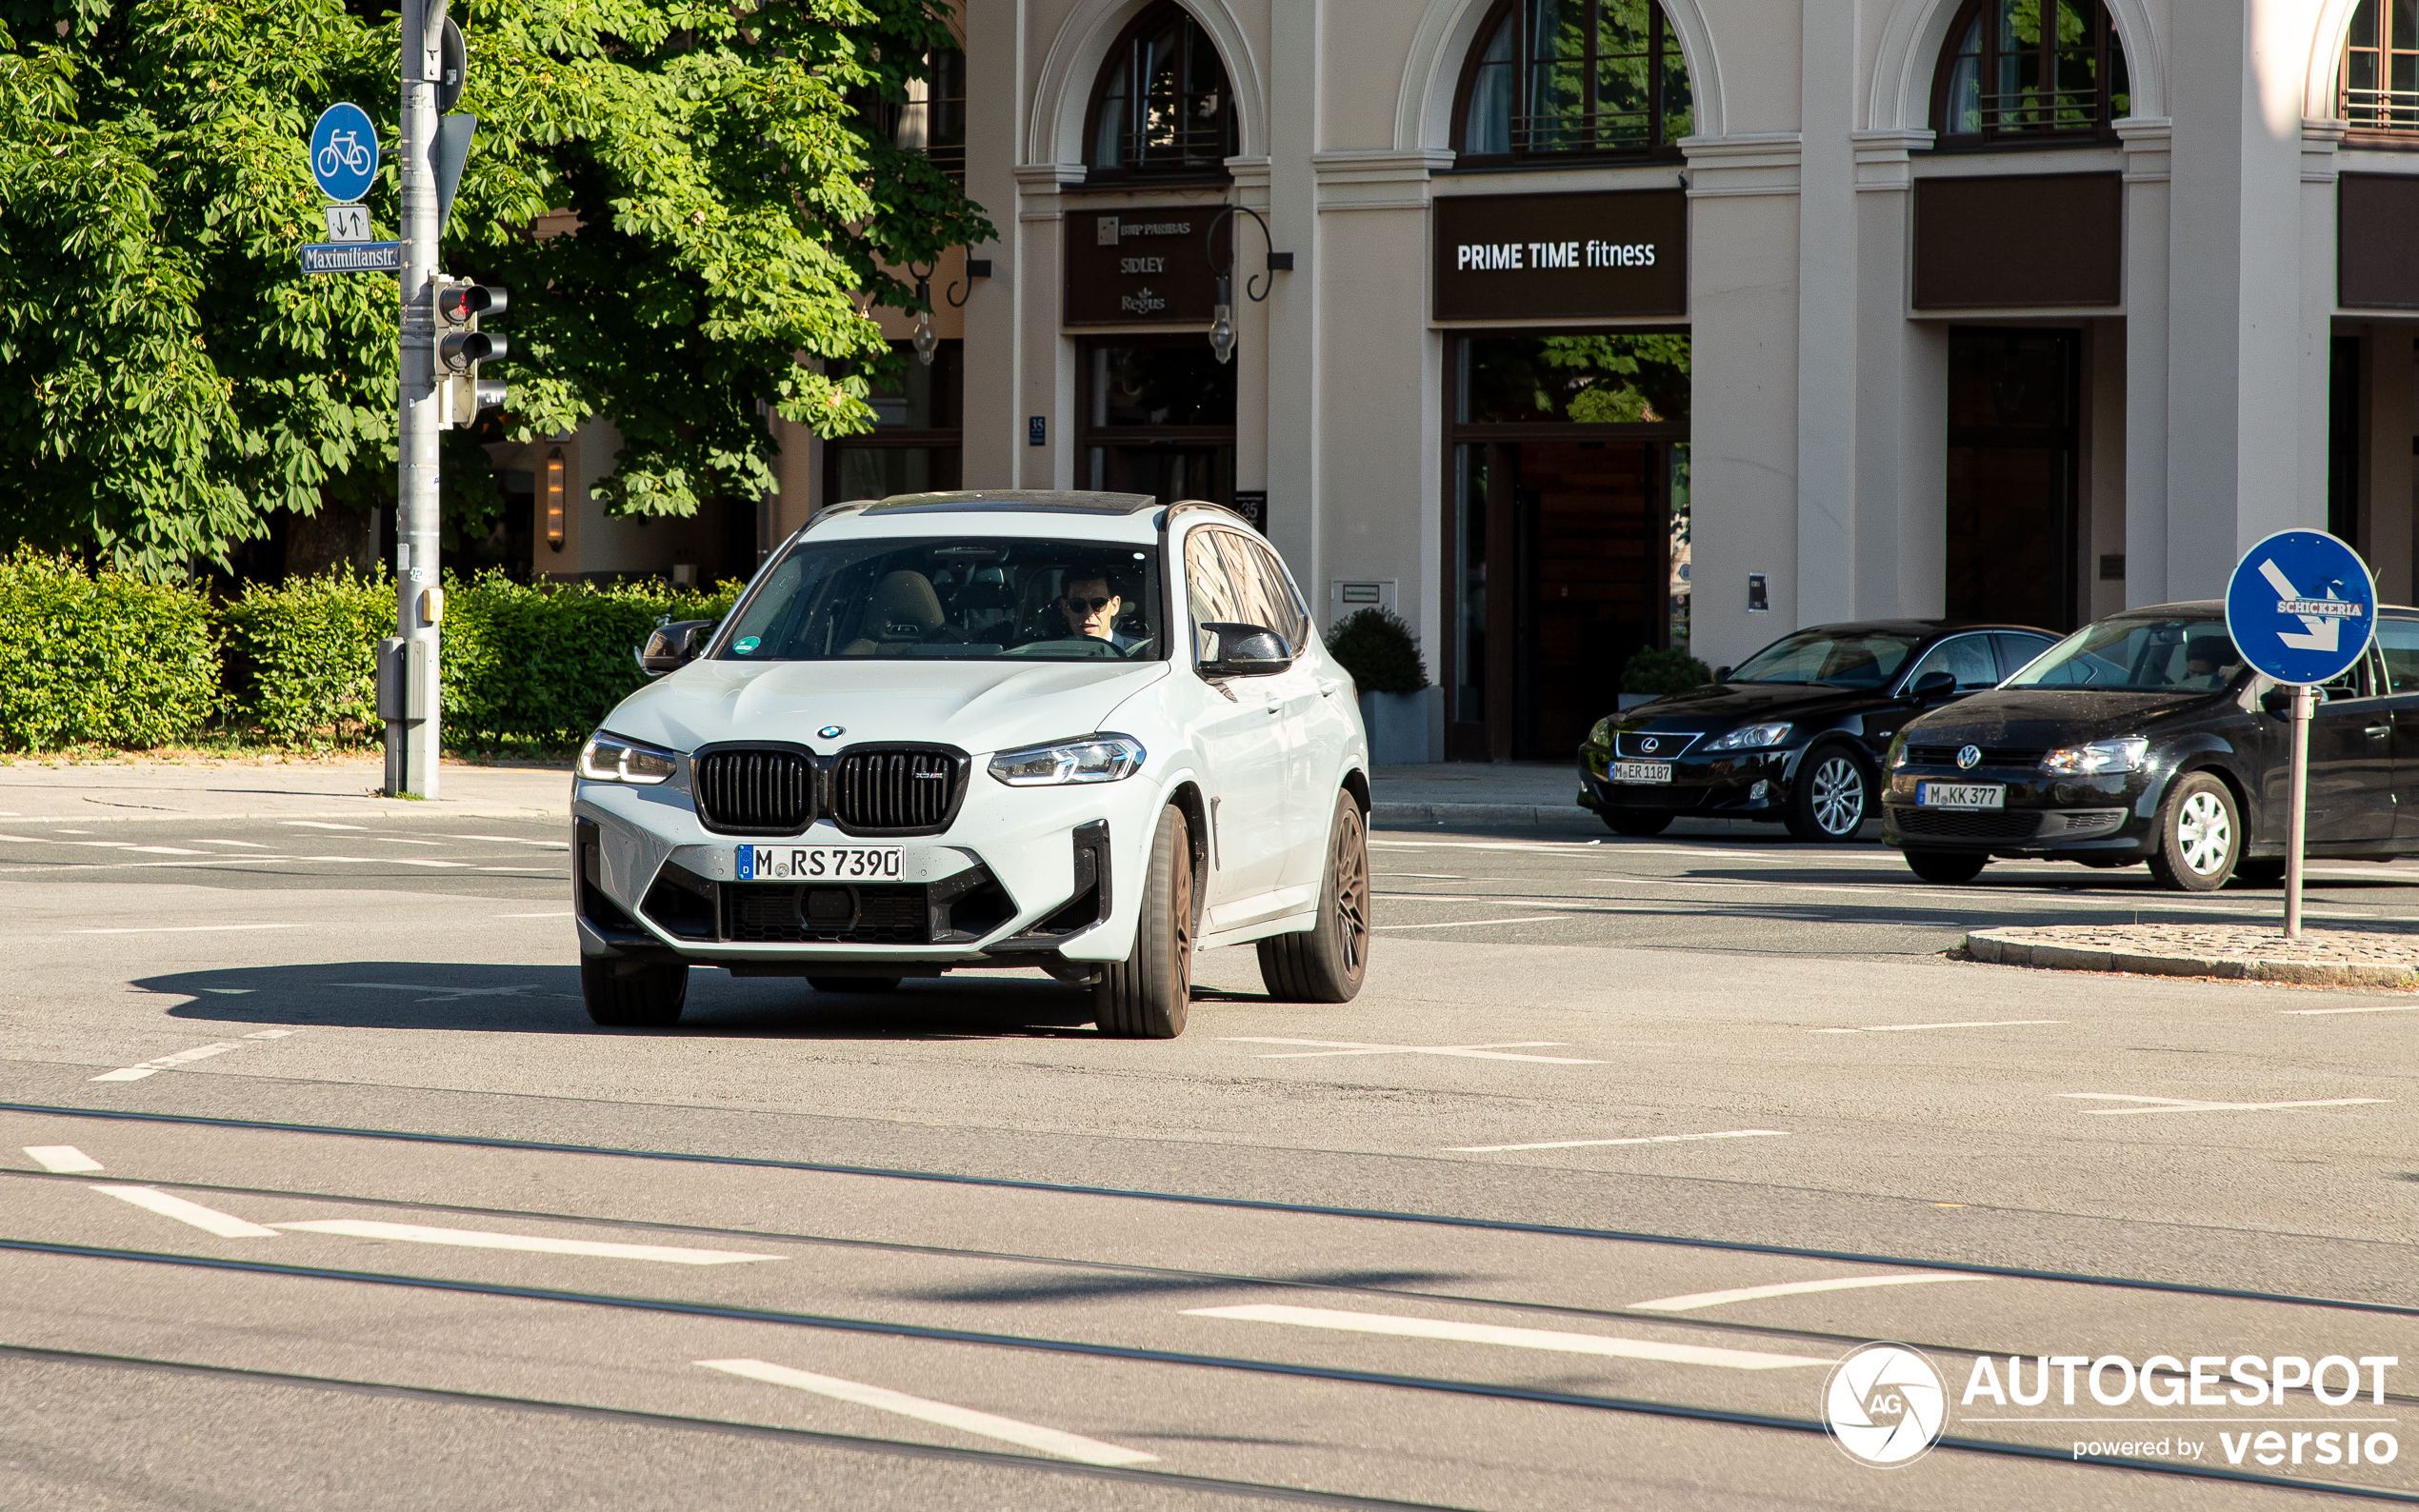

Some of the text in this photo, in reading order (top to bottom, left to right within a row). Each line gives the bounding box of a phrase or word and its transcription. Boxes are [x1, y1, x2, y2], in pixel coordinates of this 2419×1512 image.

[1120, 223, 1190, 236] BNP PARIBAS
[307, 248, 395, 269] Maximilianstr.
[1458, 240, 1655, 270] PRIME TIME fitness
[1120, 257, 1165, 273] SIDLEY
[1121, 295, 1165, 314] Regus
[1031, 418, 1044, 432] 35
[1241, 503, 1258, 518] 35
[2277, 601, 2362, 616] SCHICKERIA
[1615, 765, 1670, 780] M ER 1187
[1930, 786, 1940, 803] M
[1949, 787, 1968, 804] KK
[1970, 787, 1997, 805] 377
[755, 850, 899, 876] M RS 7390
